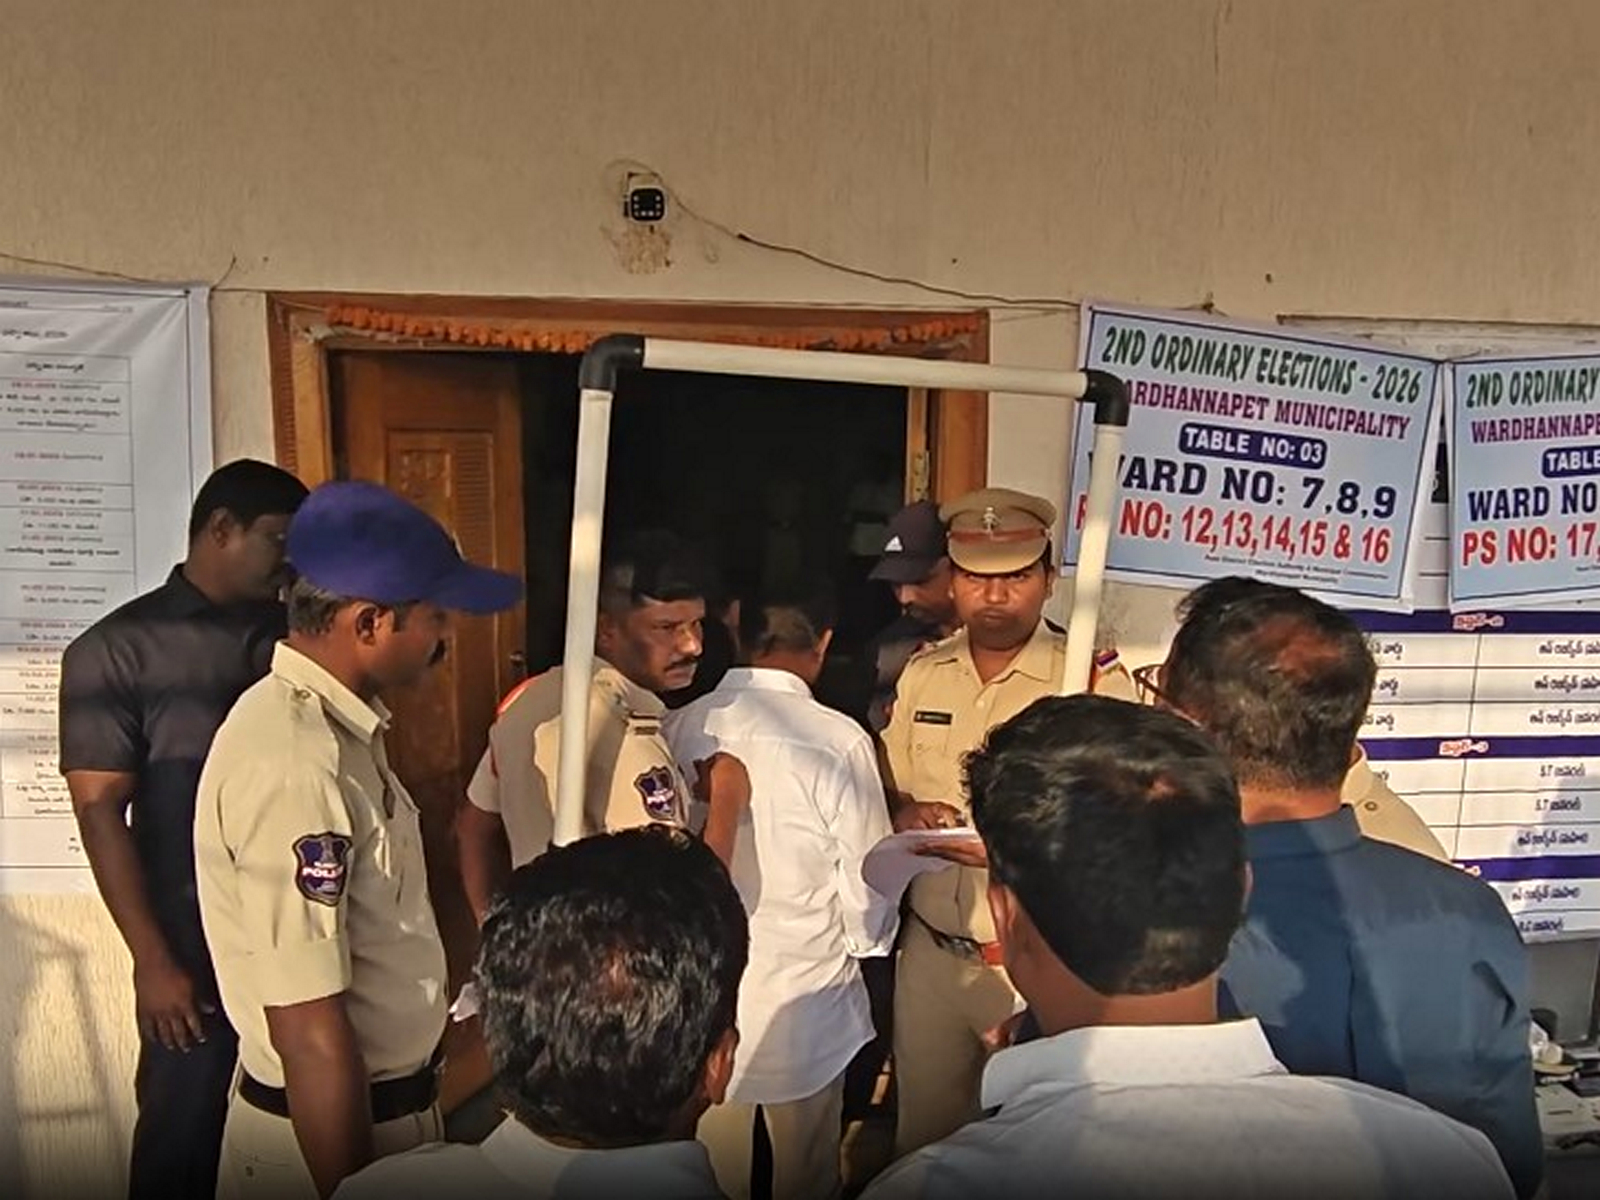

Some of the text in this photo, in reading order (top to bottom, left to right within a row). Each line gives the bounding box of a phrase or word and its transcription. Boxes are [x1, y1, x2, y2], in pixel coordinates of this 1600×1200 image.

[1102, 326, 1146, 366] 2ND
[1151, 333, 1254, 382] ORDINARY
[1256, 347, 1357, 395] ELECTIONS
[1371, 364, 1422, 403] 2026
[1466, 367, 1600, 408] 2ND ORDINARY
[1126, 379, 1410, 439] ARDHANNAPET MUNICIPALITY
[1184, 427, 1323, 463] TABLE NO: 03
[1546, 450, 1600, 472] TABLE
[1221, 467, 1285, 506] NO:
[1302, 476, 1397, 519] 7,8,9
[1468, 486, 1550, 522] WARD
[1120, 499, 1172, 540] NO:
[1182, 505, 1328, 560] 12,13,14,15
[1334, 523, 1350, 559] &
[1362, 526, 1391, 564] 16
[1463, 530, 1496, 566] PS
[1508, 526, 1556, 563] NO:
